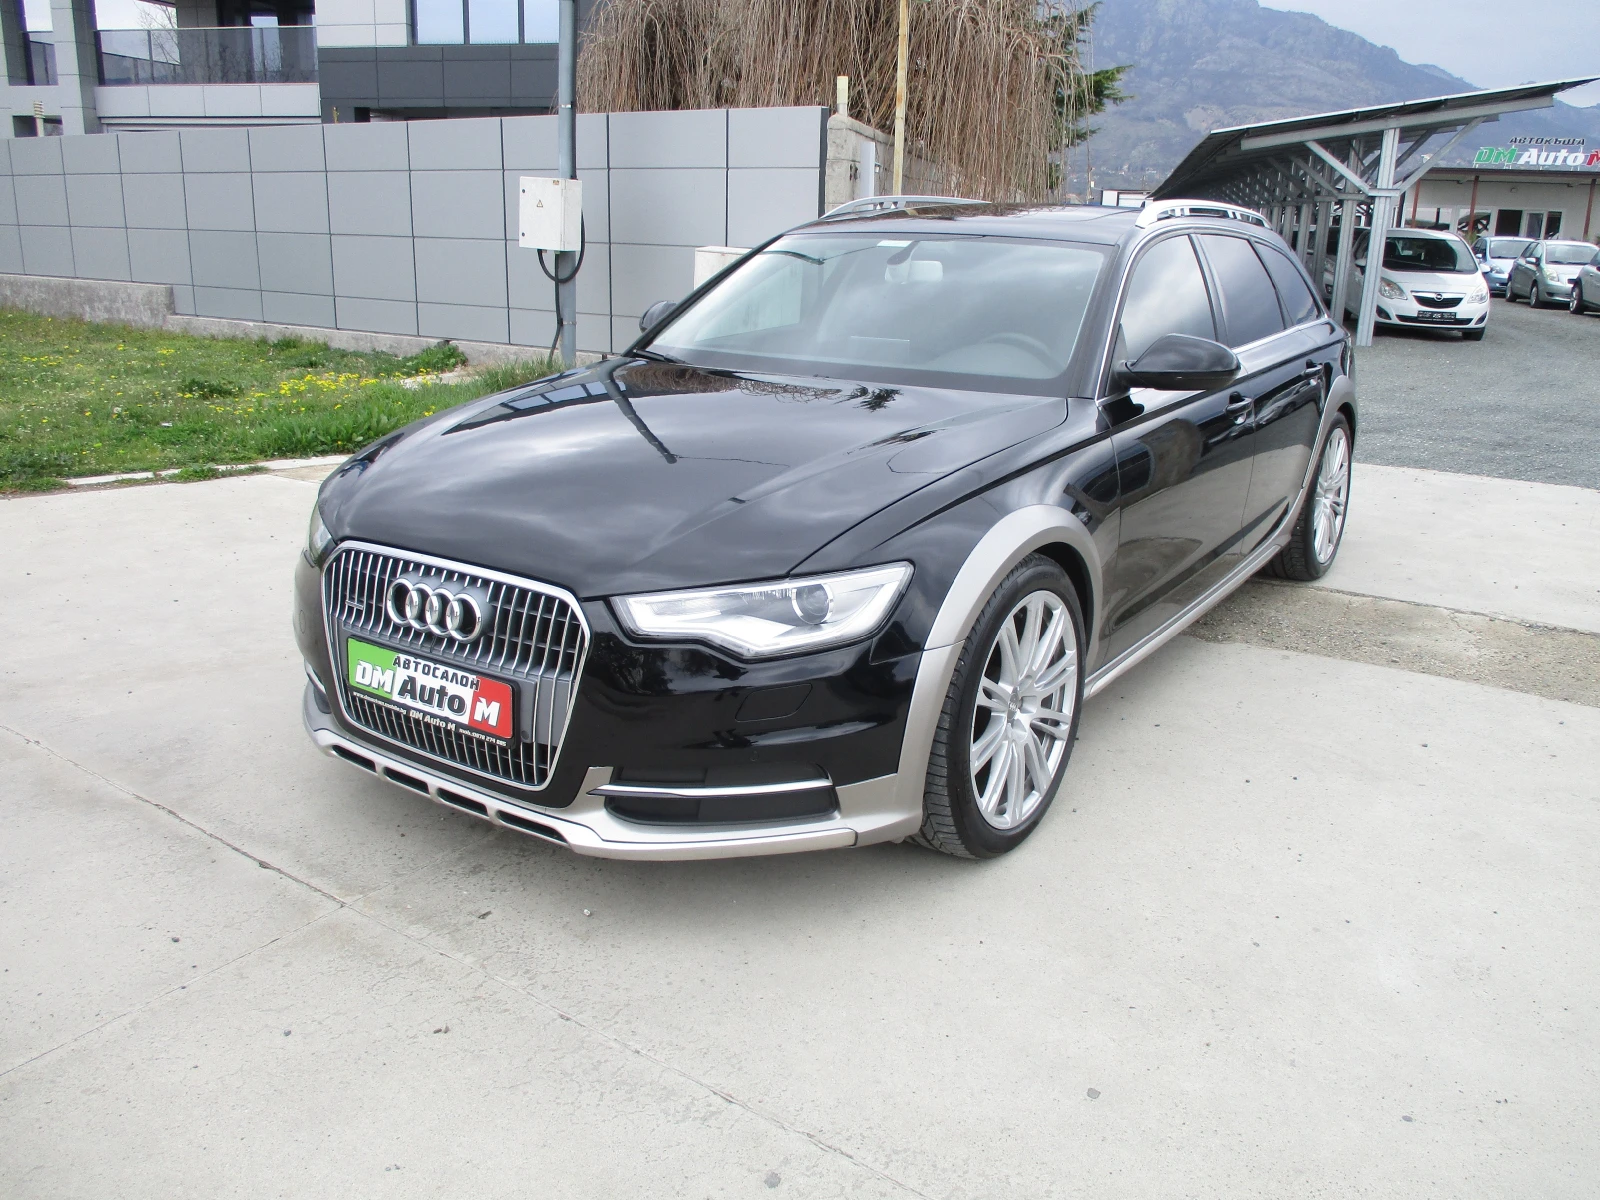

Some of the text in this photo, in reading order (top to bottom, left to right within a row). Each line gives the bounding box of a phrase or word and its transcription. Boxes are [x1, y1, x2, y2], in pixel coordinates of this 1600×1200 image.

[1473, 147, 1518, 164] DM
[1517, 148, 1585, 166] Auto
[392, 655, 481, 692] АВТОСАЛОН
[355, 659, 500, 727] DM Auto M
[409, 709, 424, 722] DM
[424, 716, 446, 728] Auto
[447, 722, 456, 732] M
